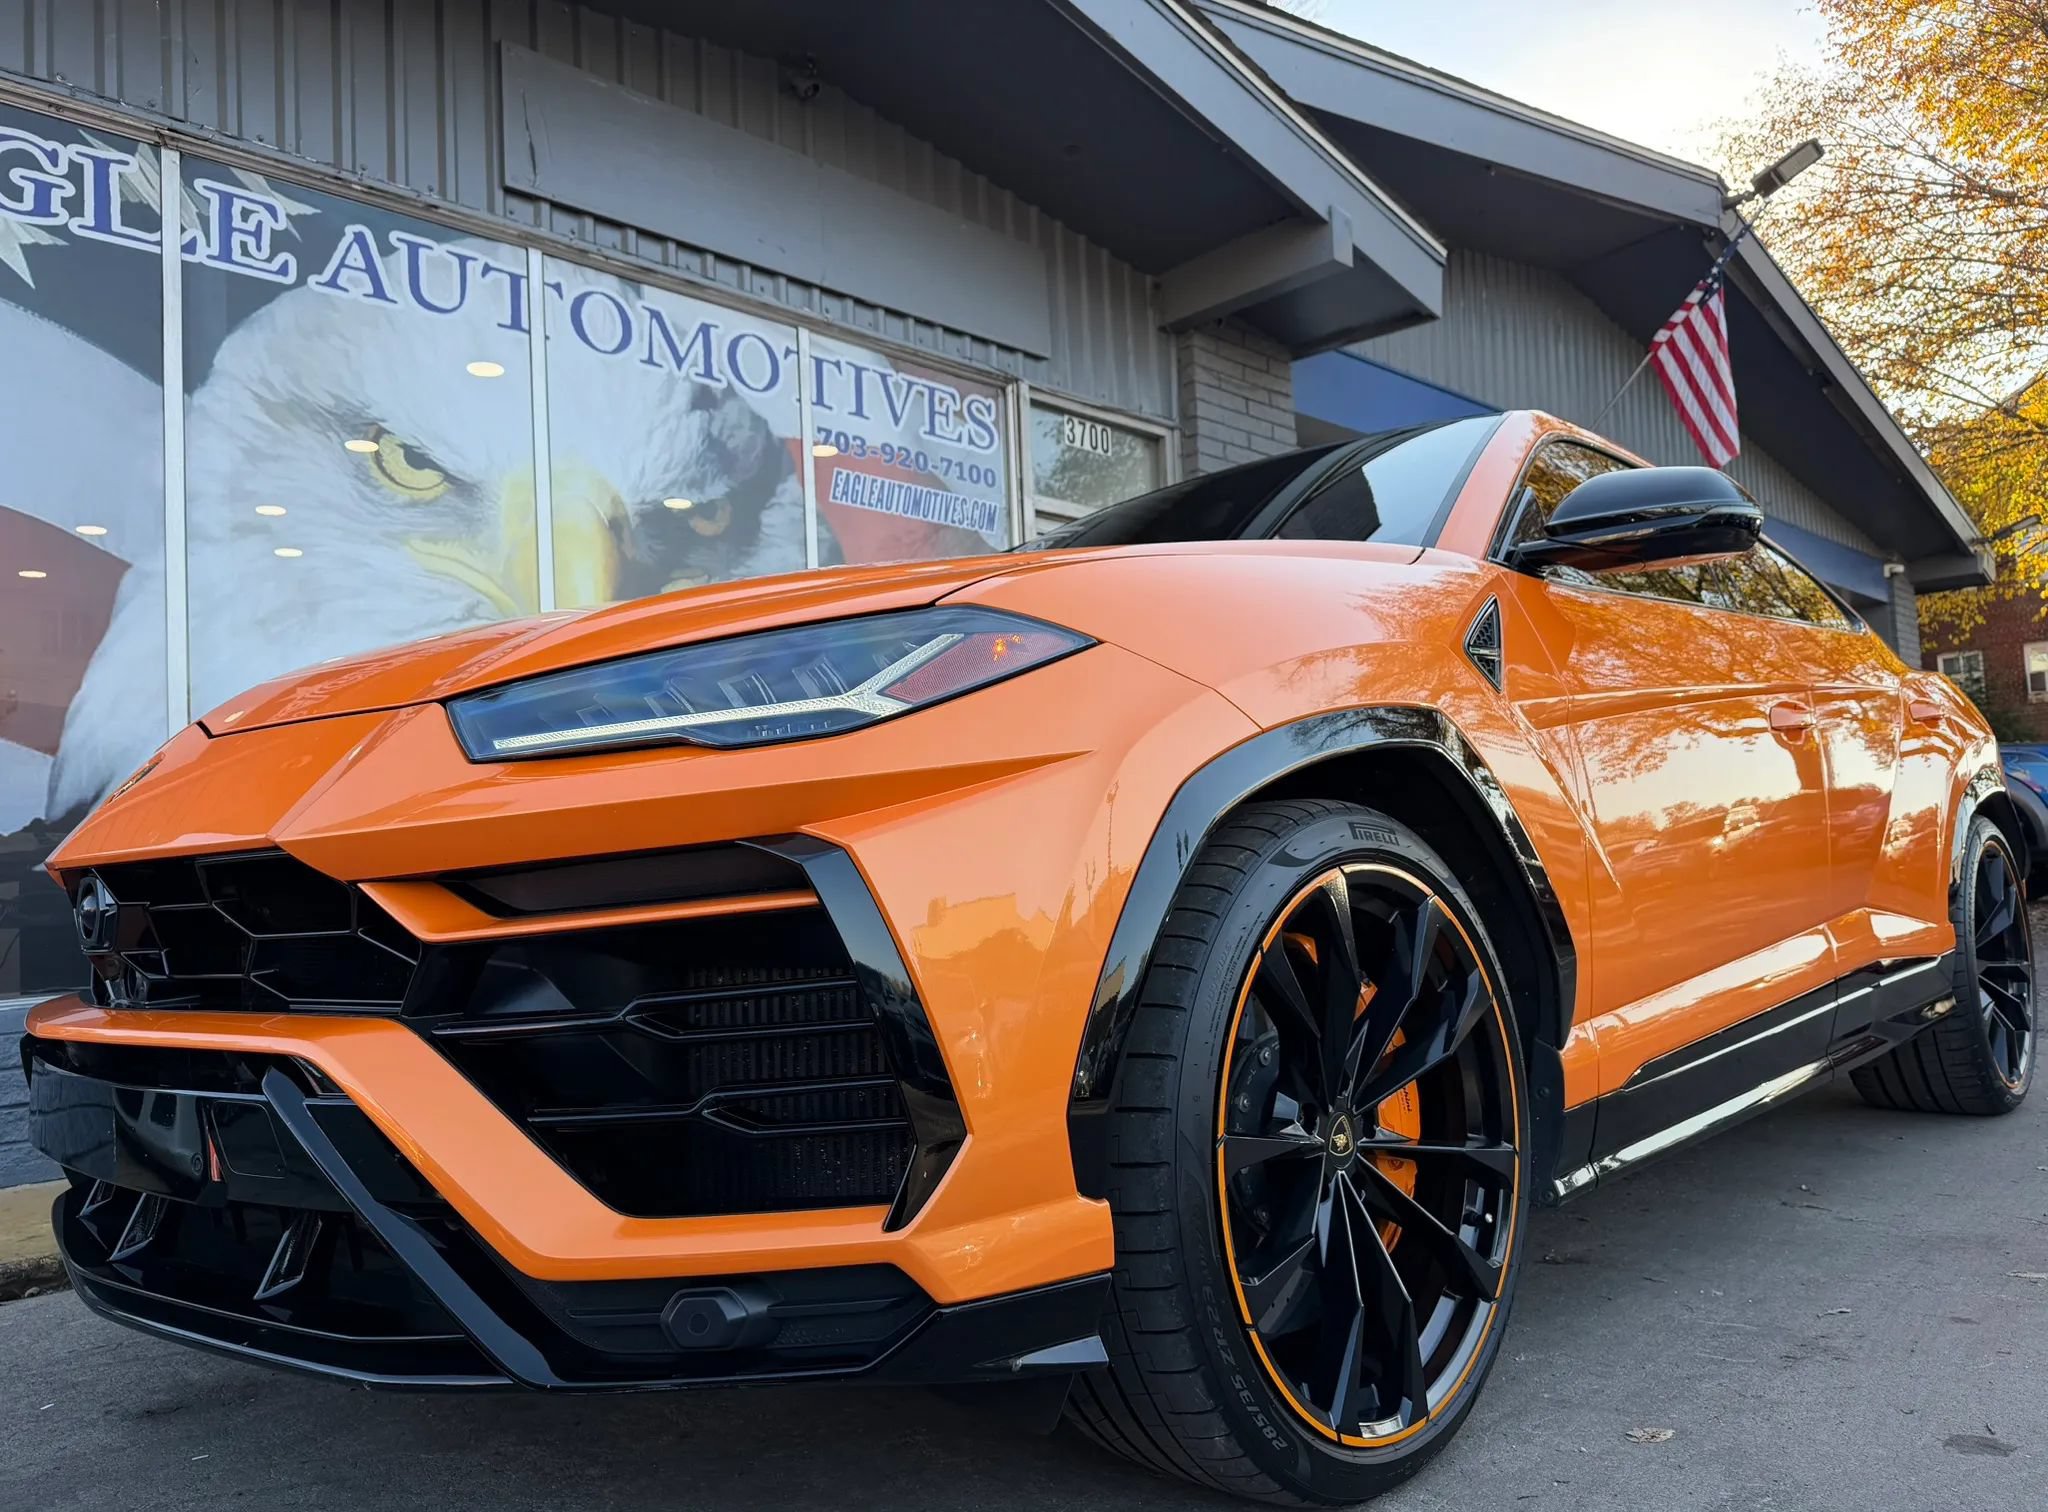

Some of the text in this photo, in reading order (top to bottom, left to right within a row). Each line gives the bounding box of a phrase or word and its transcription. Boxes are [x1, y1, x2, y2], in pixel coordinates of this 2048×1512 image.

[313, 228, 998, 451] AUTOMOTIVES
[815, 426, 997, 488] 703-920-7100
[1066, 414, 1110, 454] 3700
[831, 470, 998, 533] EAGLEAUTOMOTIVES.COM
[1347, 822, 1400, 847] PIRELLI
[1230, 1373, 1289, 1451] 285/35
